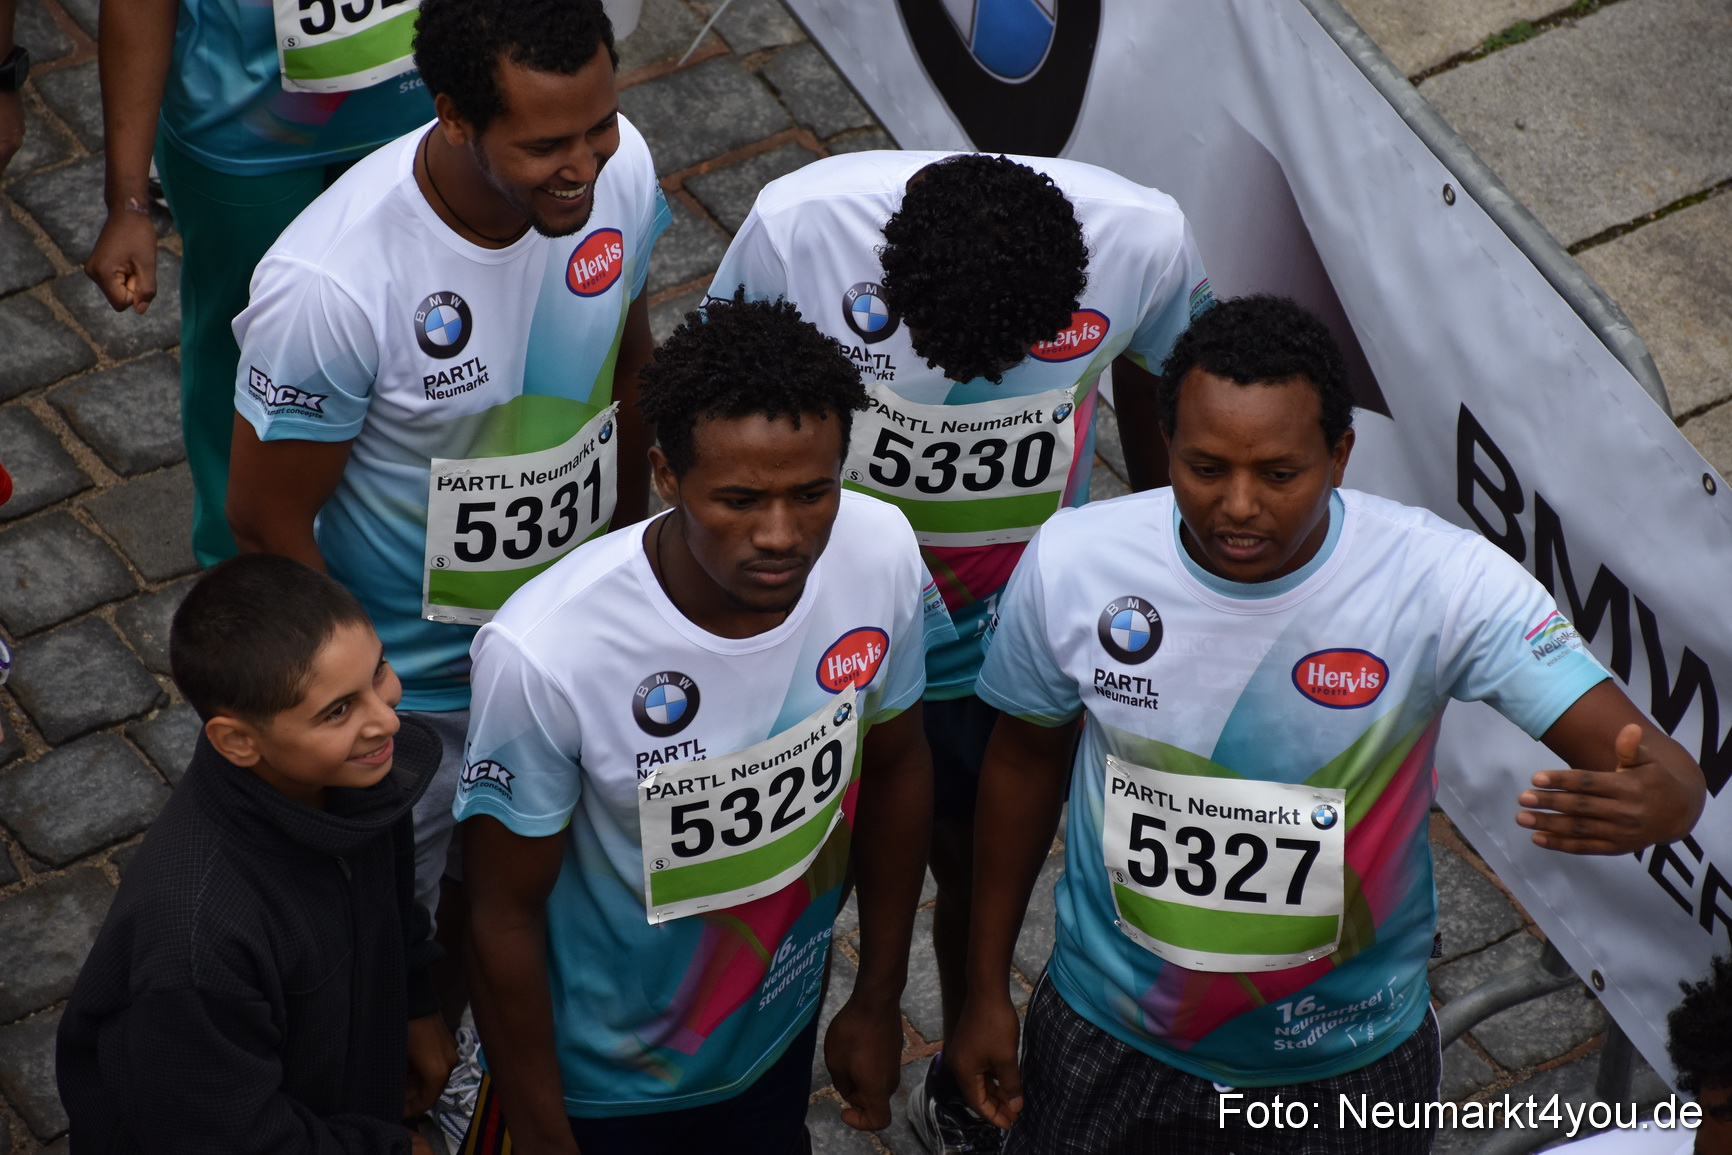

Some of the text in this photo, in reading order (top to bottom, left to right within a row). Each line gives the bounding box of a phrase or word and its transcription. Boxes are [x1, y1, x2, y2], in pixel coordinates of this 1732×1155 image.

[573, 243, 622, 284] Hervis
[415, 294, 462, 323] BMW
[423, 357, 487, 390] PARTL
[425, 372, 490, 400] Neumarkt
[868, 398, 1043, 434] PARTL Neumarkt
[437, 438, 595, 492] PARTL Neumarkt
[850, 471, 859, 481] S
[868, 427, 1056, 494] 5330
[454, 457, 601, 563] 5331
[436, 557, 445, 568] S
[1106, 597, 1159, 623] BMW
[1456, 401, 1732, 799] BMW
[827, 642, 881, 680] Hervis
[1307, 662, 1380, 693] Hervis
[636, 673, 692, 698] BMW
[1094, 668, 1159, 697] PARTL
[1094, 686, 1158, 710] Neumarkt
[636, 739, 706, 768] PARTL
[646, 774, 726, 800] PARTL
[731, 724, 827, 781] Neumarkt
[671, 739, 843, 858] 5329
[1111, 777, 1300, 826] PARTL Neumarkt
[656, 860, 664, 870] S
[1127, 812, 1321, 905] 5327
[1116, 872, 1124, 883] S
[762, 927, 832, 994] Neumarkte
[769, 934, 797, 973] 16.
[759, 947, 818, 1011] Stadtlauf
[1275, 989, 1383, 1037] Neumarkter
[1276, 995, 1326, 1024] 16.
[1274, 1012, 1363, 1050] Stadtlauf
